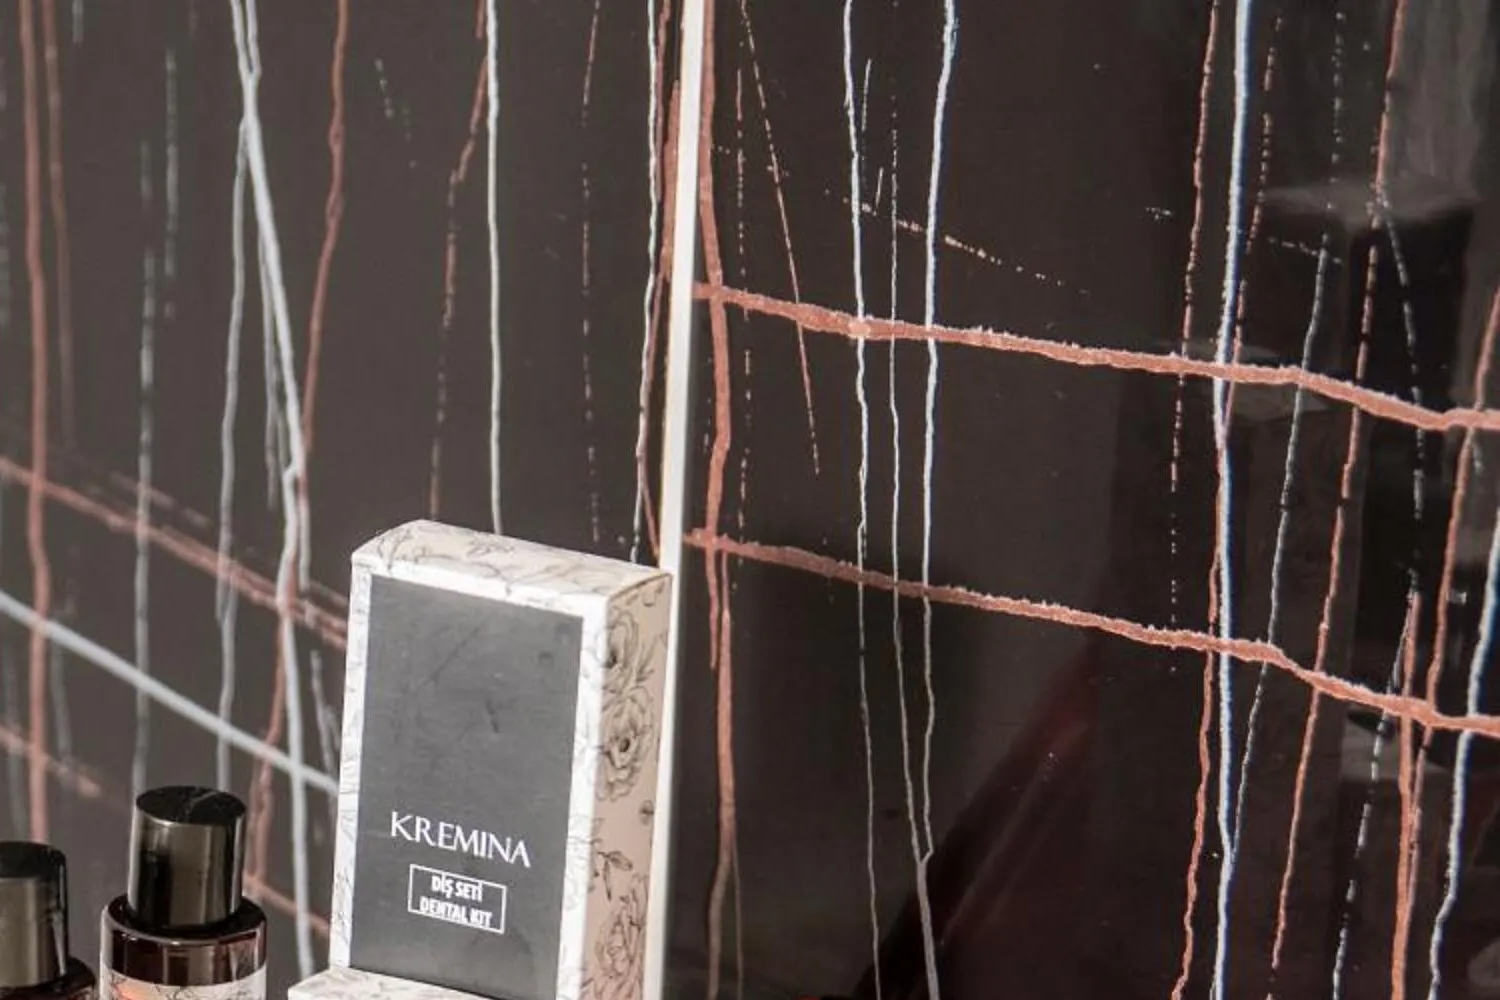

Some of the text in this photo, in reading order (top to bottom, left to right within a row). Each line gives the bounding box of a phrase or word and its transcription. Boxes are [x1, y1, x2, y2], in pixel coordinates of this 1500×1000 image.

[390, 811, 531, 869] KREMINA
[420, 896, 493, 928] DENTAL KIT
